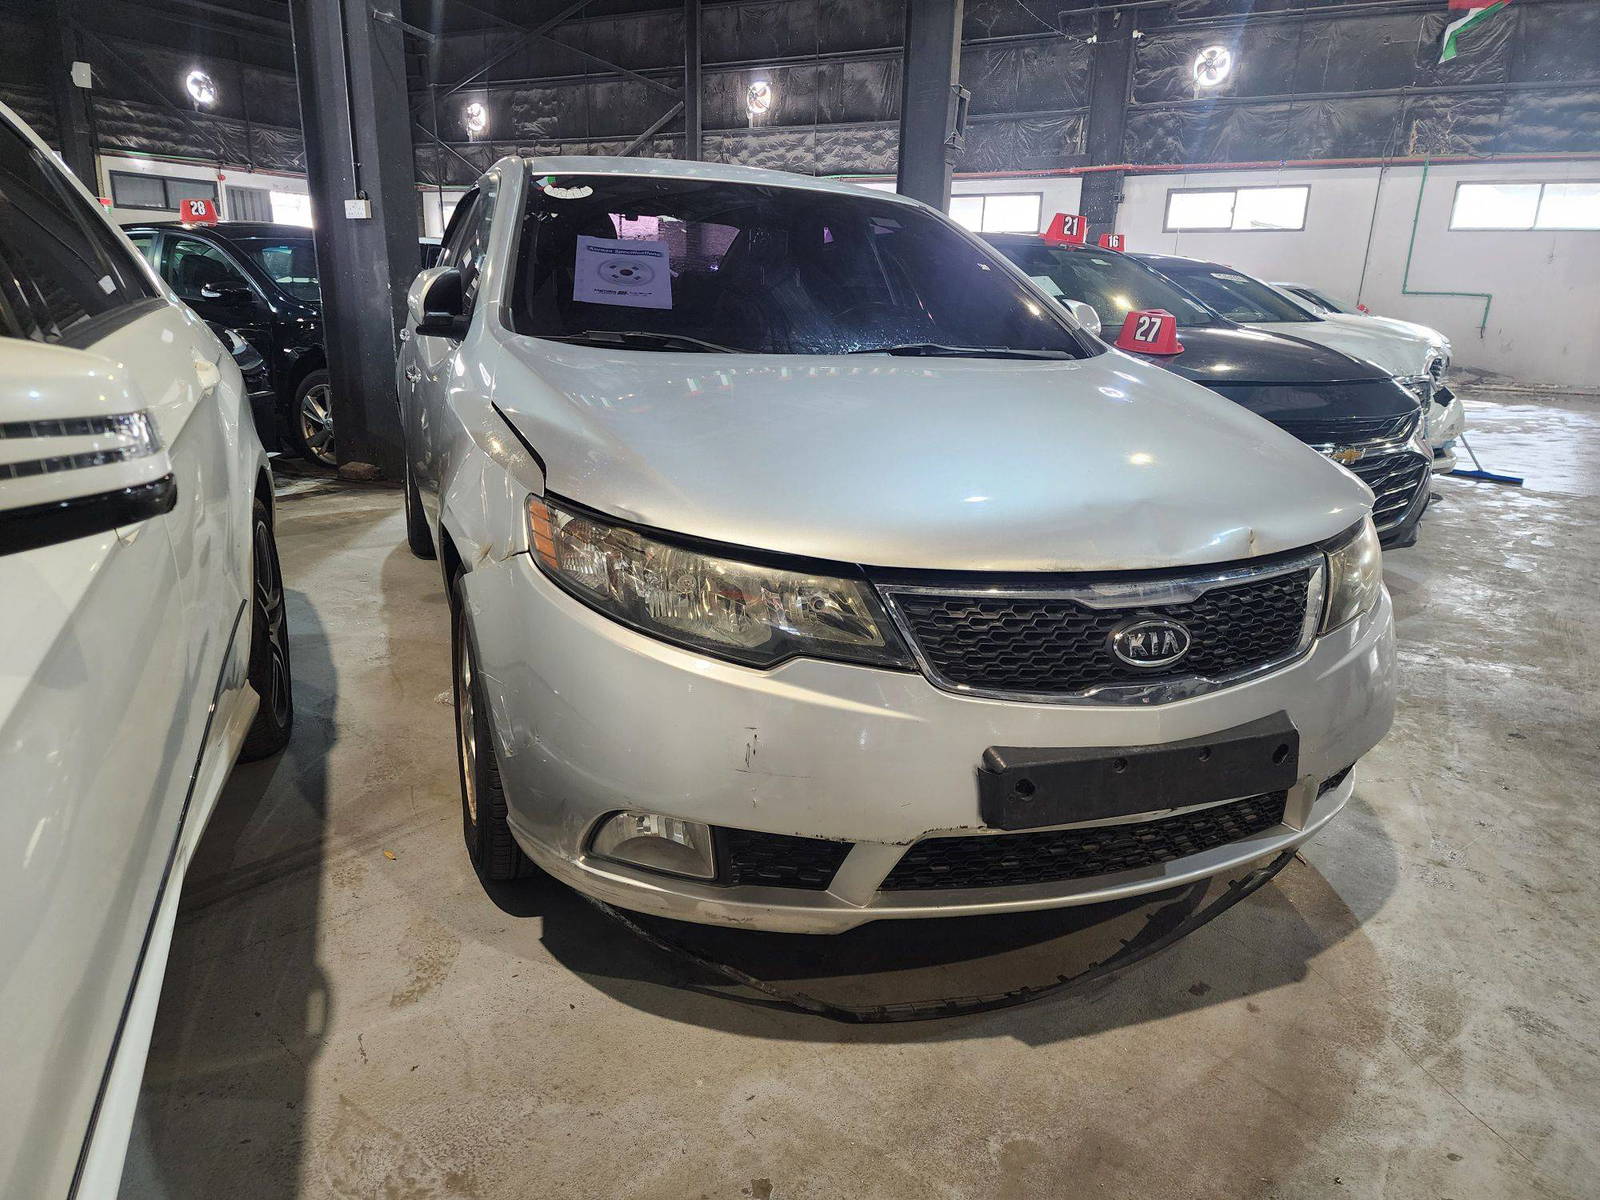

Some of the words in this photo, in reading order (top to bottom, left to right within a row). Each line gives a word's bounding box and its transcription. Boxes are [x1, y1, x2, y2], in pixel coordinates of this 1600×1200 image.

[190, 200, 206, 216] 28
[1063, 216, 1079, 236] 21
[1108, 235, 1119, 248] 16
[1135, 316, 1162, 342] 27
[1127, 630, 1180, 657] KIA
